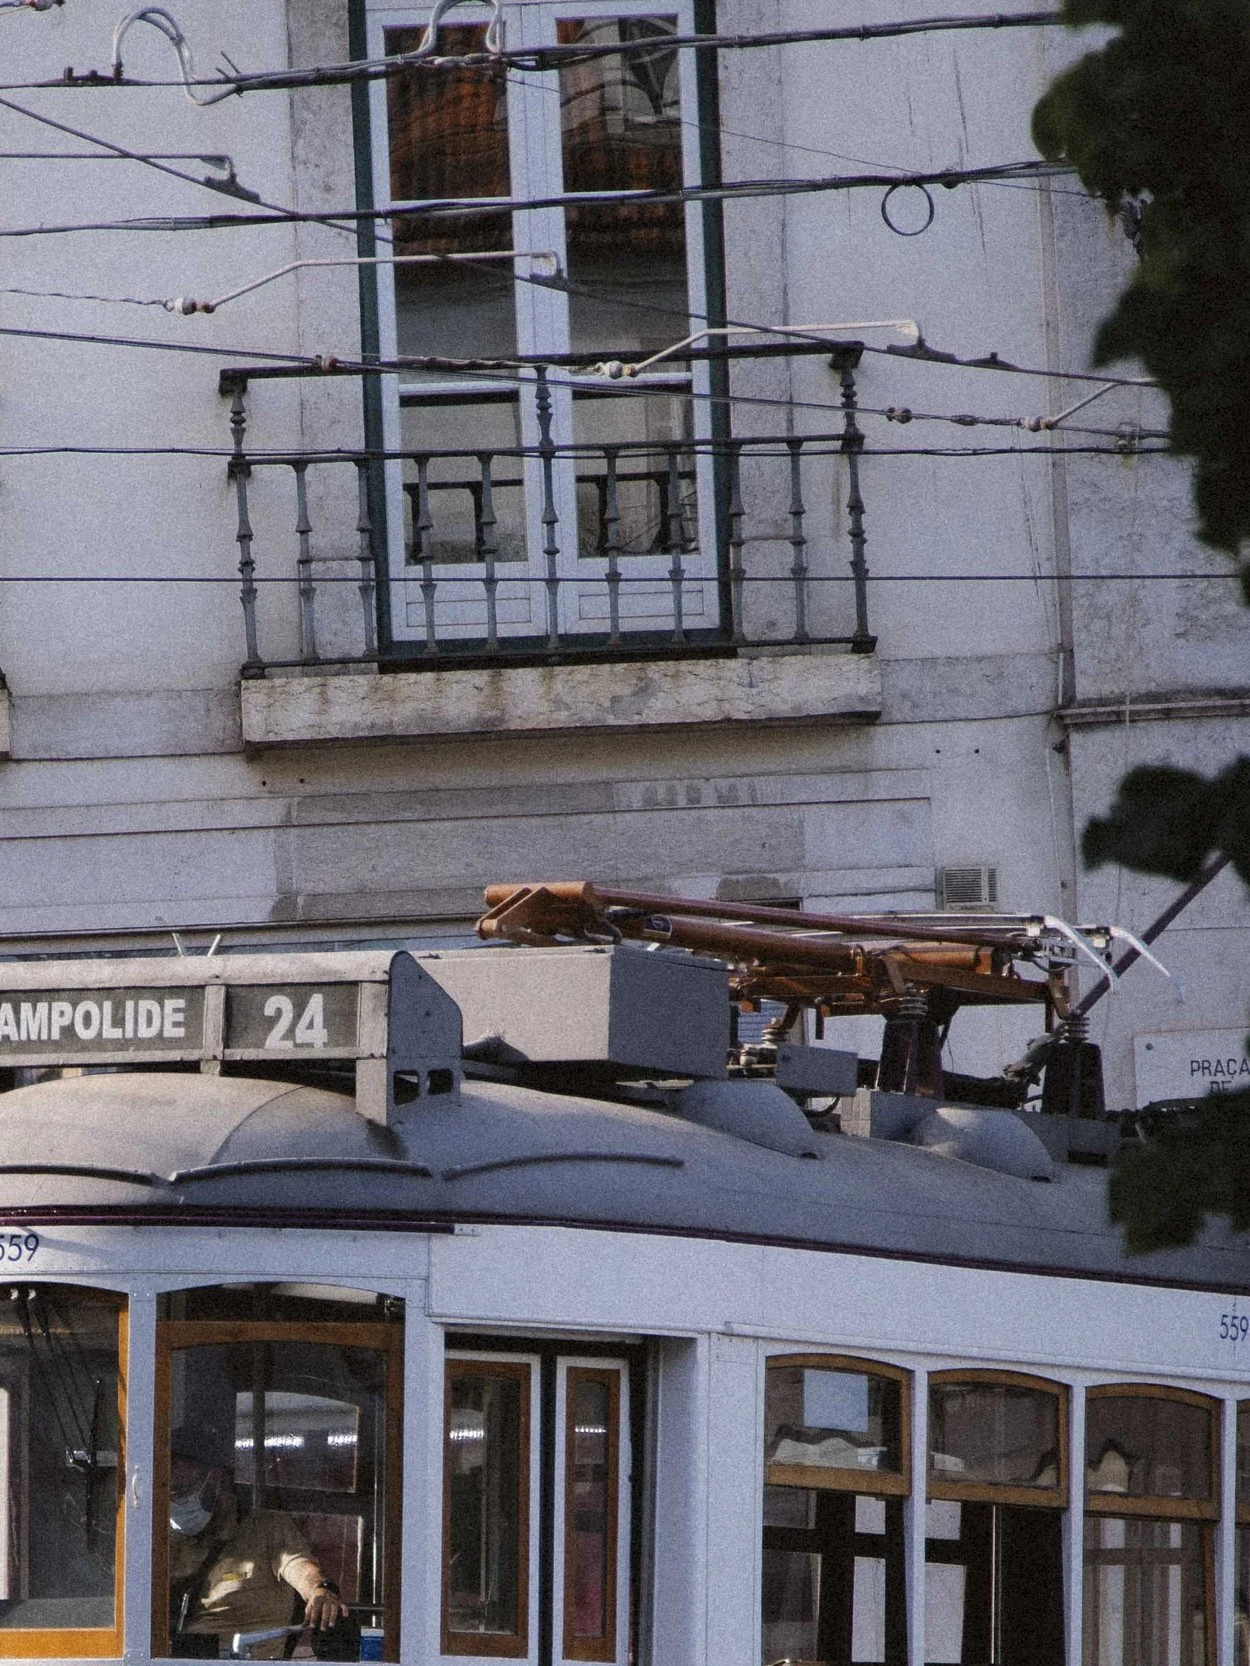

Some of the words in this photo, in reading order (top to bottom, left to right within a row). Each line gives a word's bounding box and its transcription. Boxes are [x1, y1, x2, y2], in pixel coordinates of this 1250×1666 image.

[263, 992, 329, 1050] 24
[1190, 1057, 1250, 1080] PRAÇA
[1219, 1314, 1250, 1343] 559
